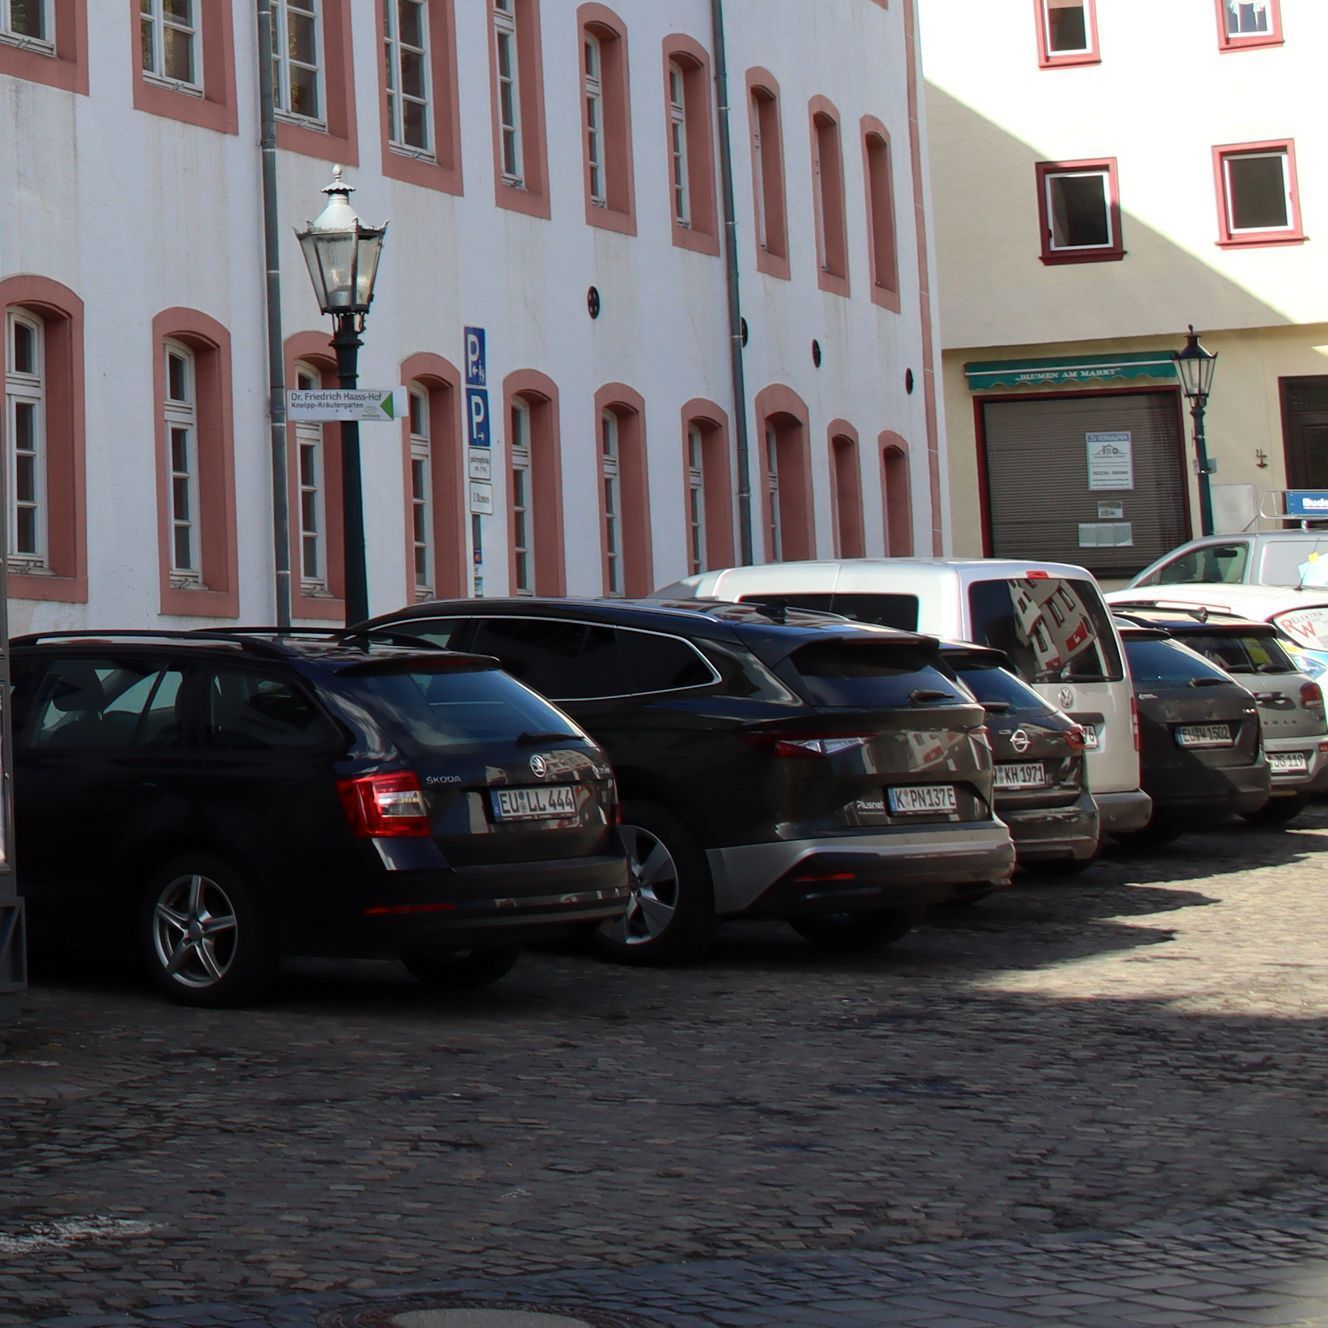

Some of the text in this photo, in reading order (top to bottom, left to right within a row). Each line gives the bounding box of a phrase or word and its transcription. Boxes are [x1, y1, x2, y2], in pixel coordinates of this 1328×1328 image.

[467, 333, 479, 378] P
[1061, 370, 1077, 378] AM
[290, 392, 382, 401] Dr. Friedrich Haass-Hof
[290, 401, 364, 409] Kneipp-Kräutergarten
[470, 394, 484, 440] P
[426, 775, 462, 784] ŠKODA
[1004, 766, 1018, 783] KH
[1020, 765, 1044, 783] 1971
[499, 789, 574, 814] EU LL 444
[895, 790, 904, 809] K
